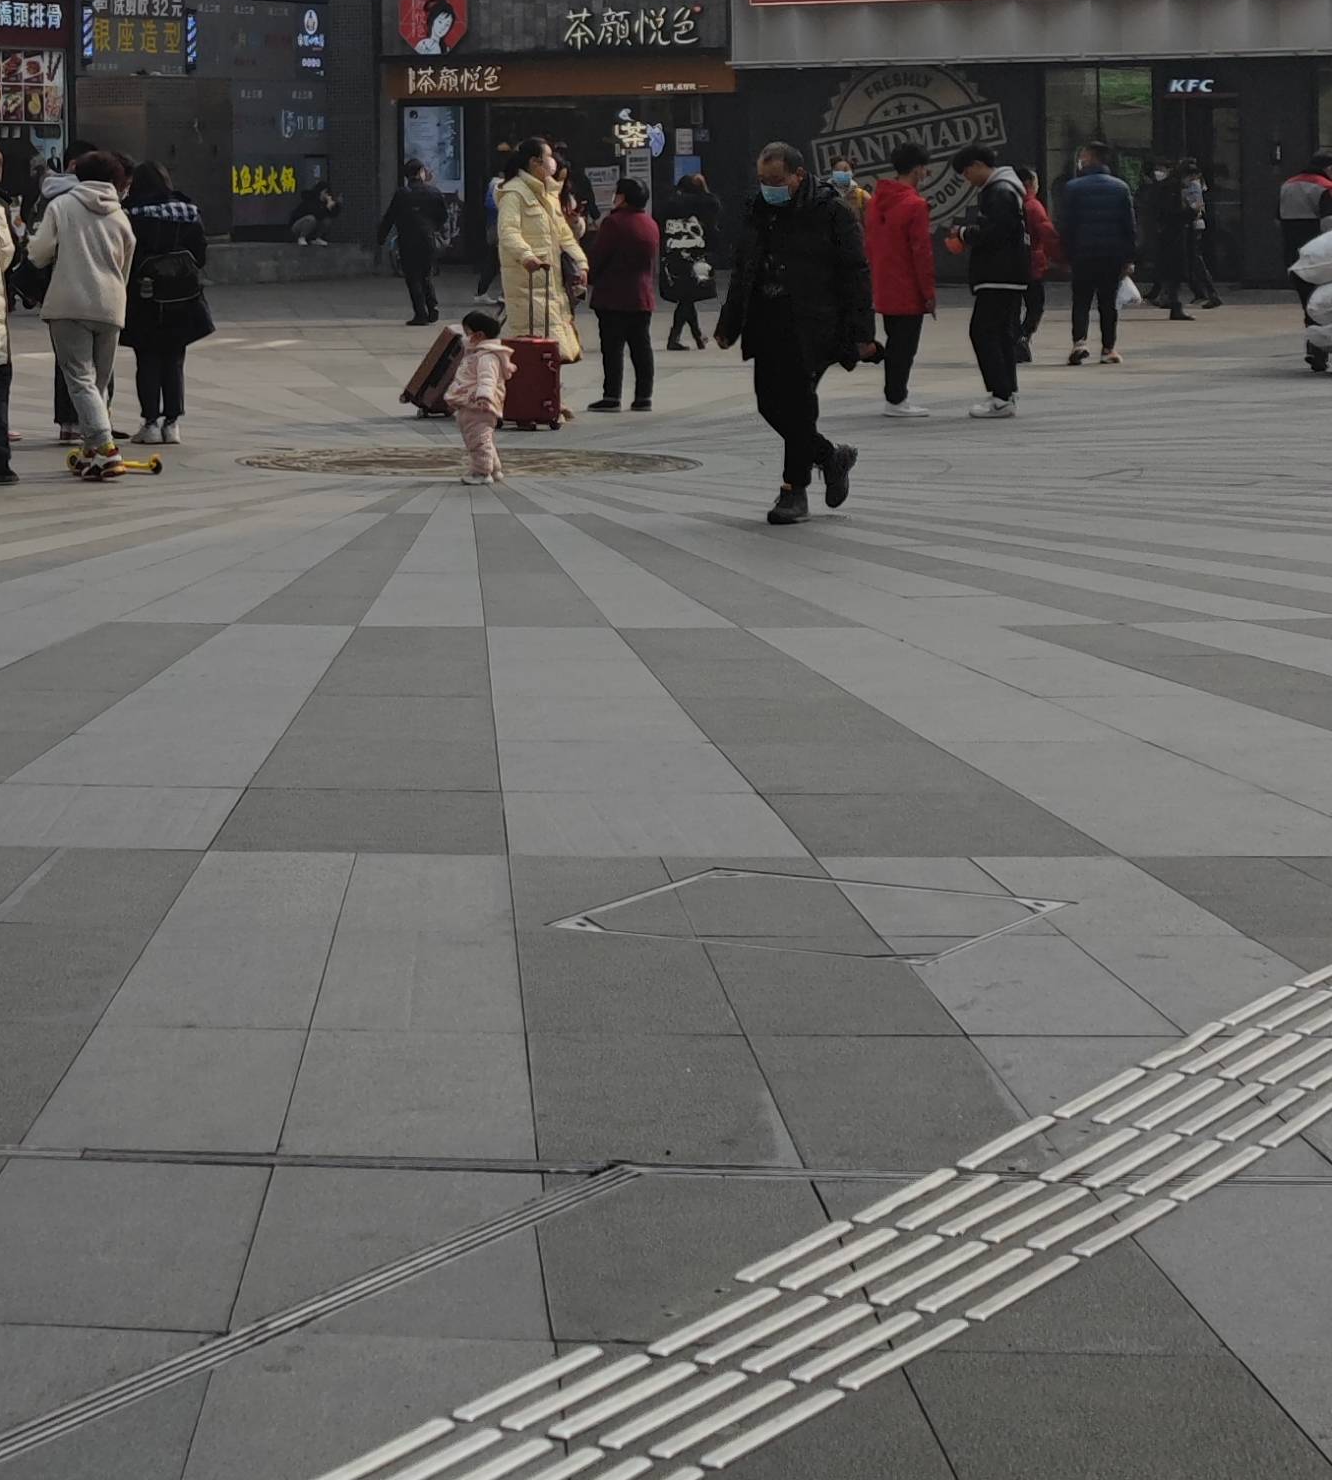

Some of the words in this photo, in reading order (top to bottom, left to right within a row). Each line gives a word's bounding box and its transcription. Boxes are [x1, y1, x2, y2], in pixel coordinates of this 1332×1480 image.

[94, 17, 181, 54] 银座造型
[863, 71, 934, 101] FRESHLY
[1170, 79, 1215, 92] KFC
[820, 111, 999, 173] HANDMADE
